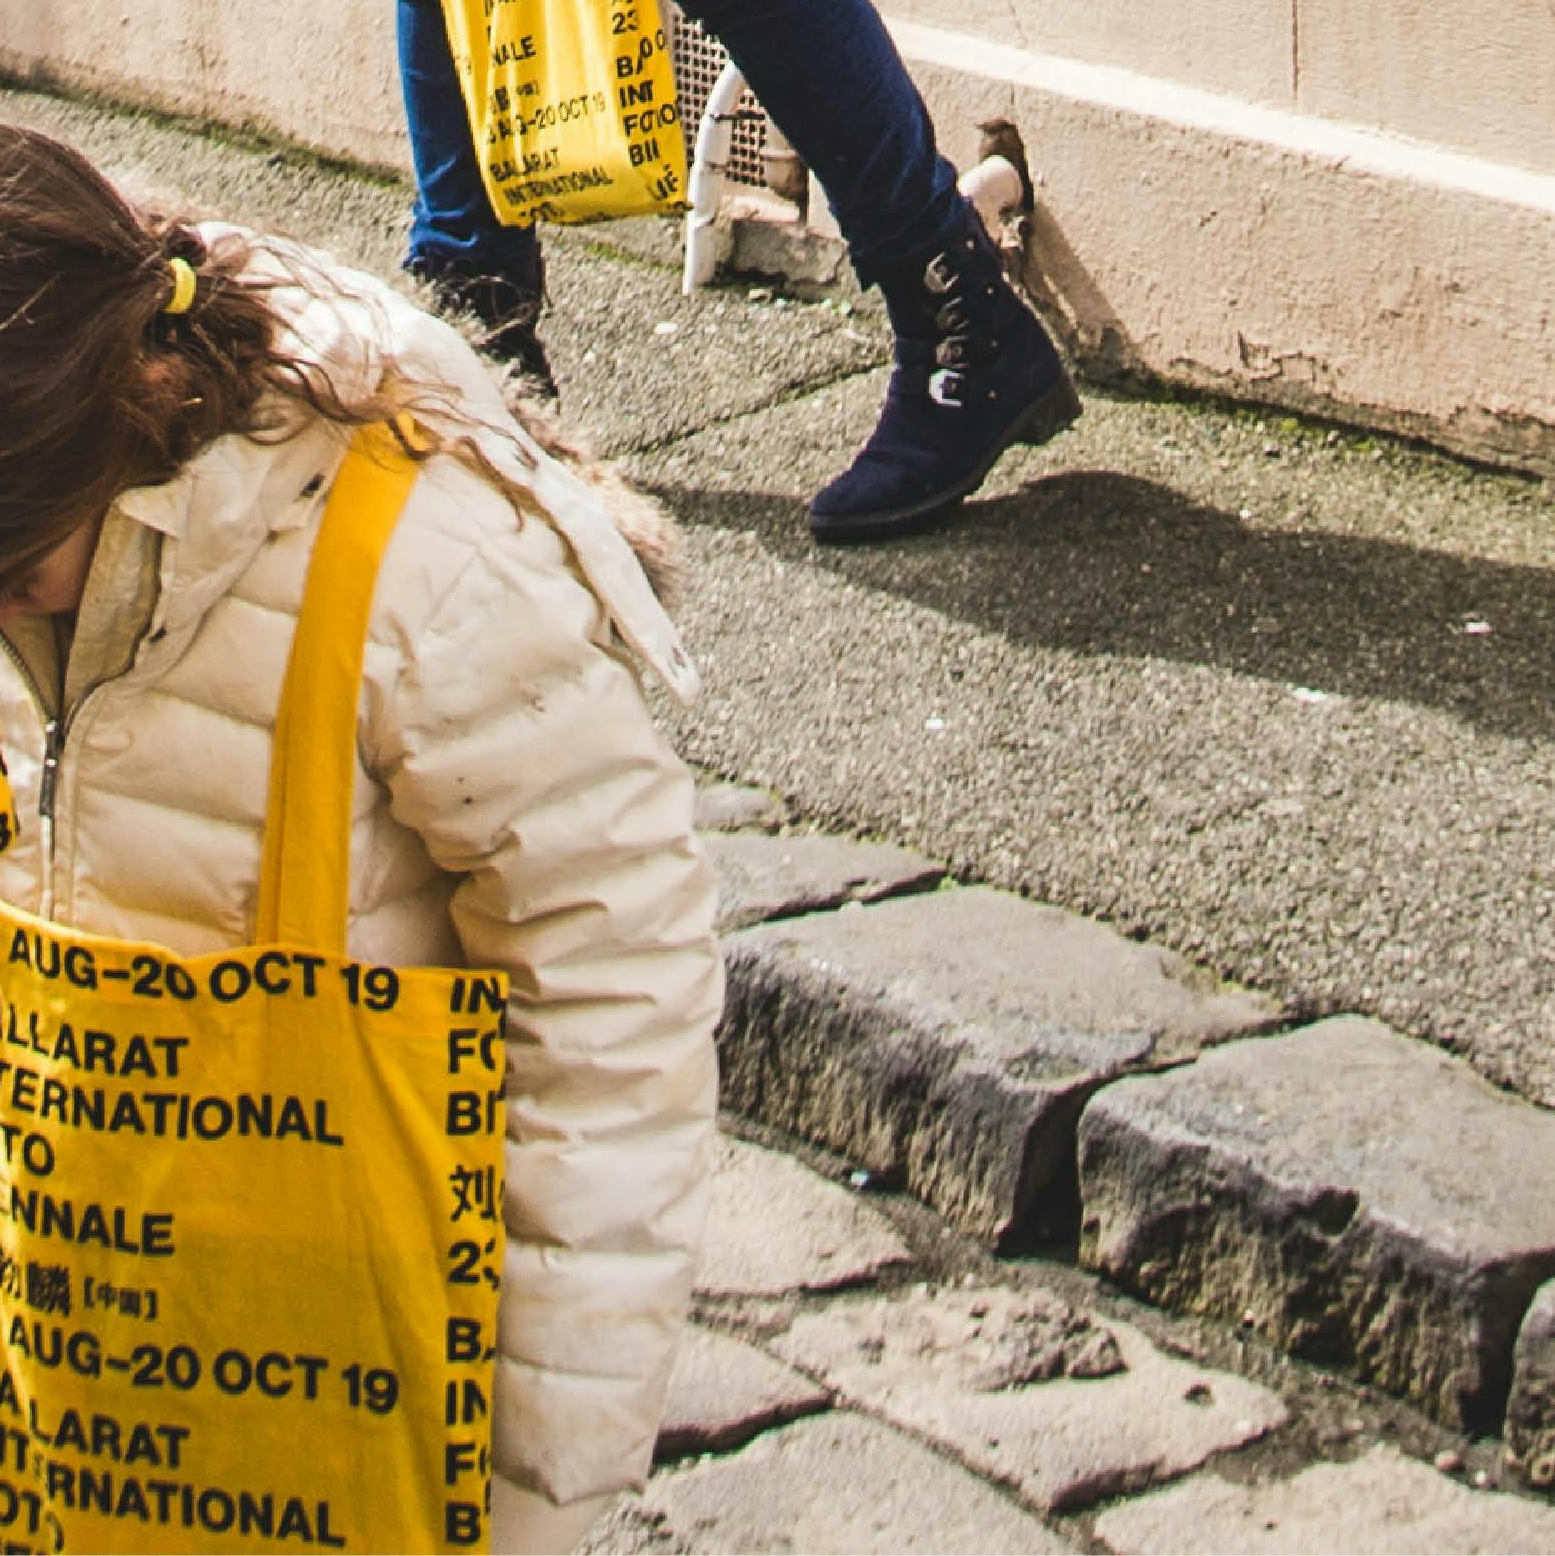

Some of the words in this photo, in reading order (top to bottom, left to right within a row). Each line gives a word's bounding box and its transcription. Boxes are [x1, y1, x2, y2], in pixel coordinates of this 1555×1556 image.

[209, 950, 327, 1003] OCT
[340, 963, 400, 1012] 19
[213, 1347, 329, 1401] OCT
[341, 1362, 400, 1416] 19
